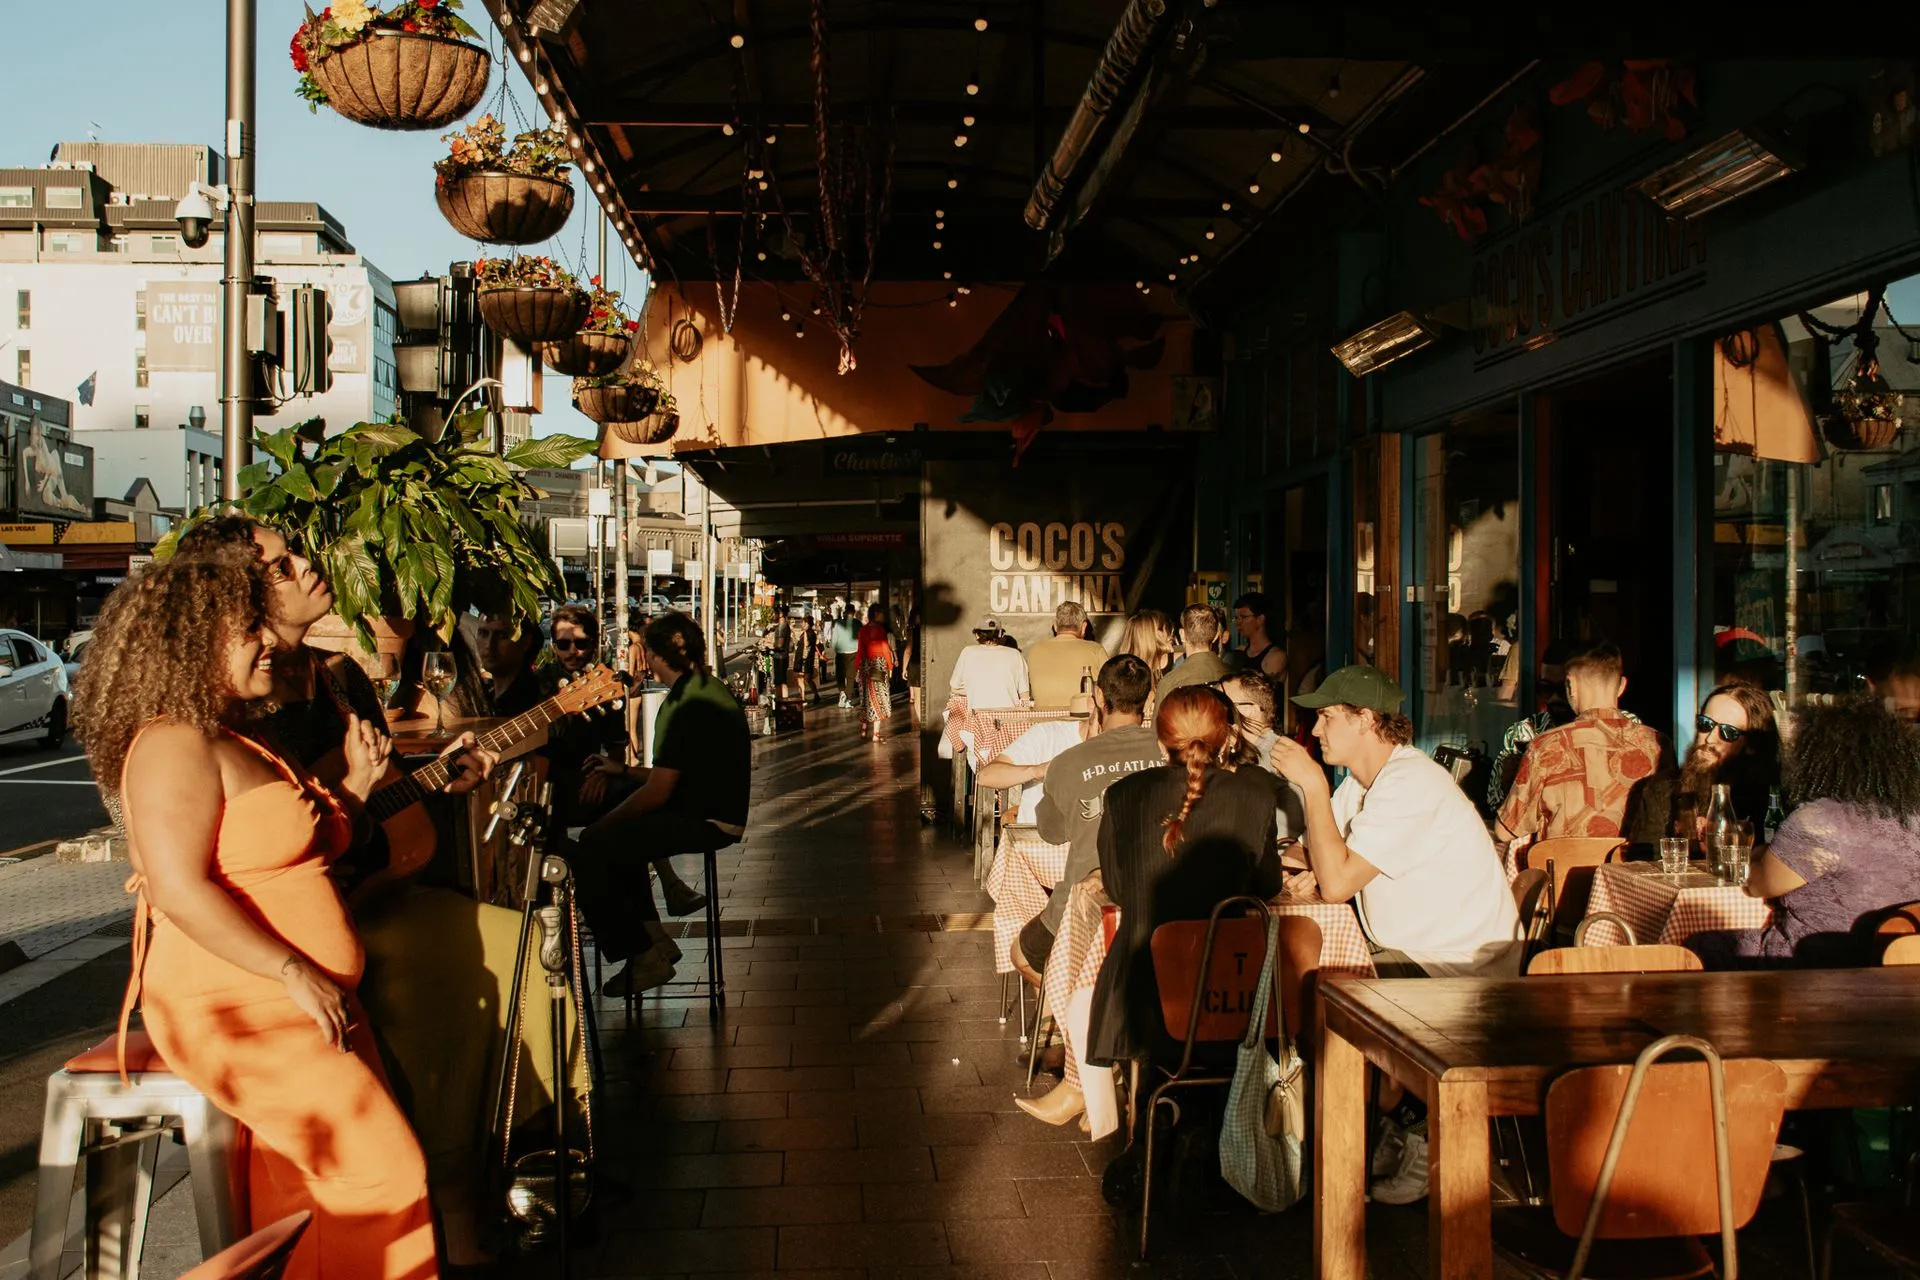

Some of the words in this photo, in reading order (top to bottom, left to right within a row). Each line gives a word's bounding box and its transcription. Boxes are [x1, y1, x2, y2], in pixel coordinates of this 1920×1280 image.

[1561, 189, 1707, 318] CANTINA
[152, 304, 198, 324] CAN'T
[173, 325, 213, 344] OVER
[990, 522, 1126, 572] COCO'S
[990, 575, 1126, 613] CANTINA
[1108, 762, 1121, 773] of
